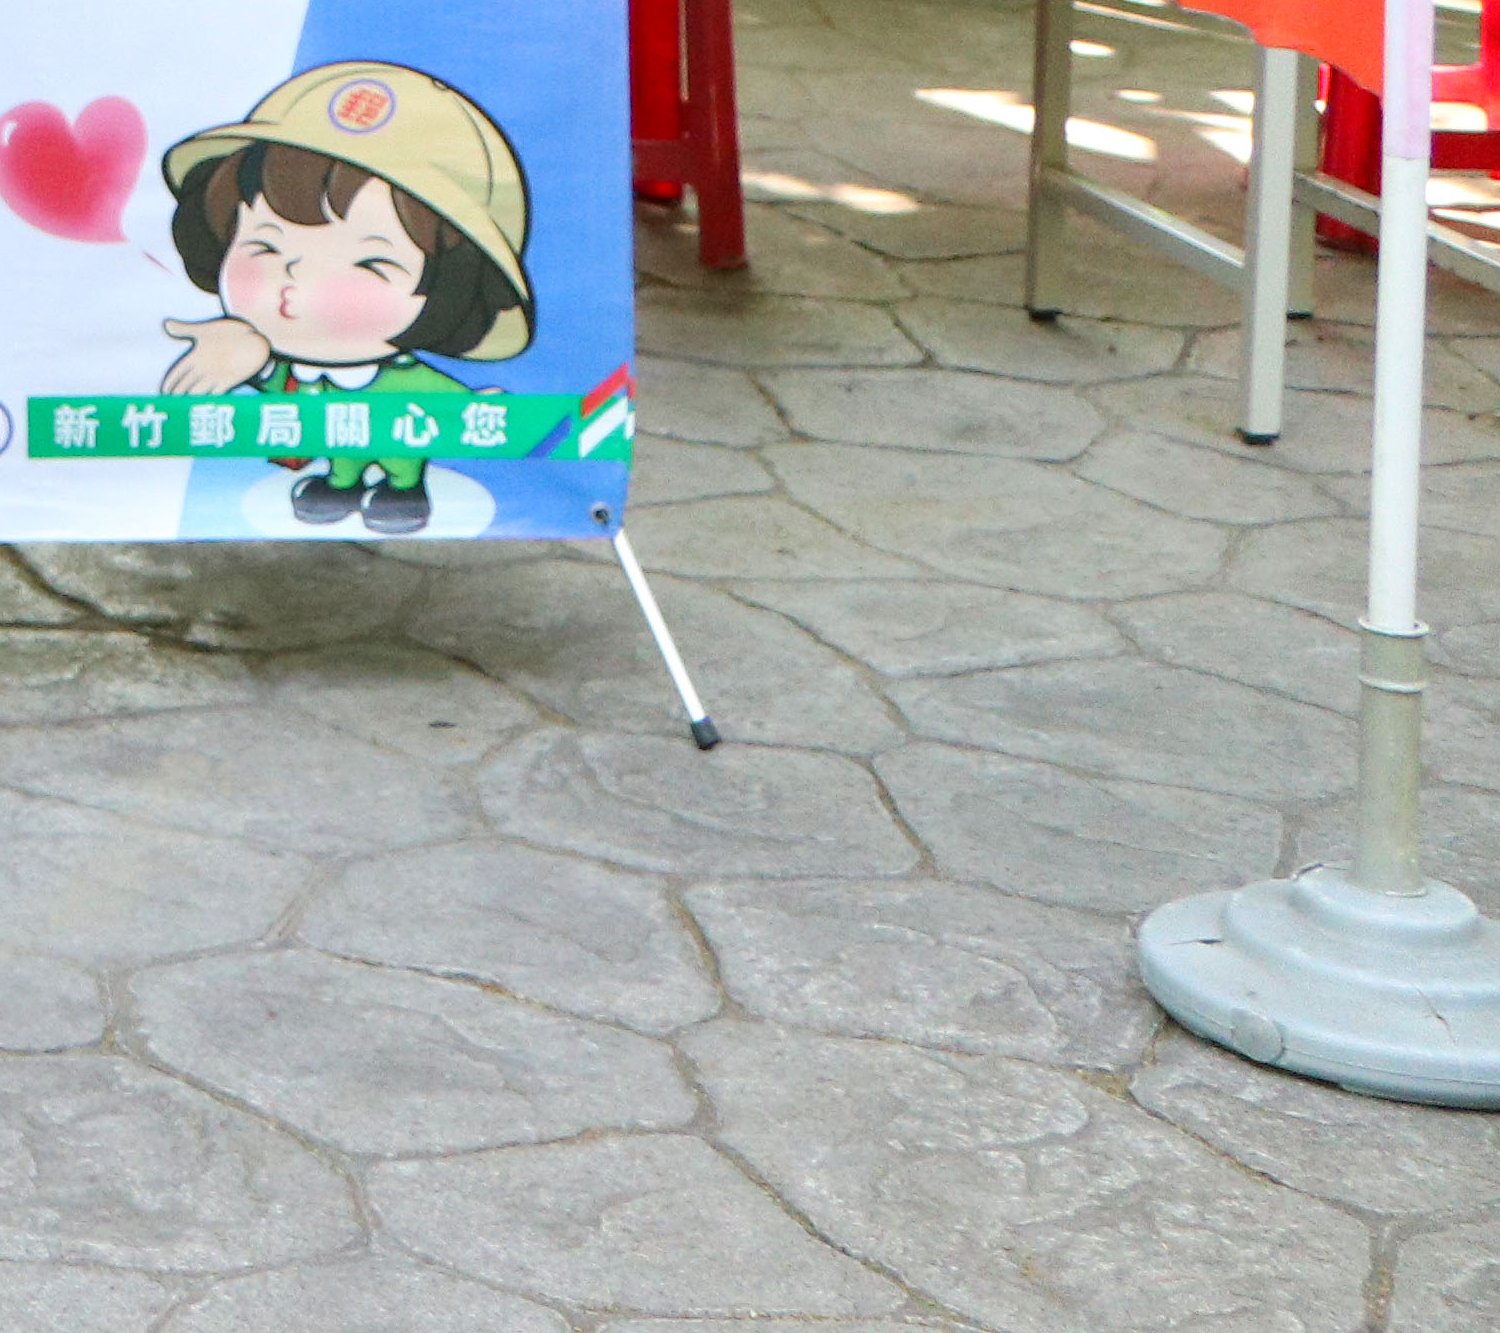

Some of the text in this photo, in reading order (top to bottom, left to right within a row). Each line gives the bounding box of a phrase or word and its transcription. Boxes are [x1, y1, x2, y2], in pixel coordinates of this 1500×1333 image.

[53, 402, 509, 452] 新竹郵局關心您
